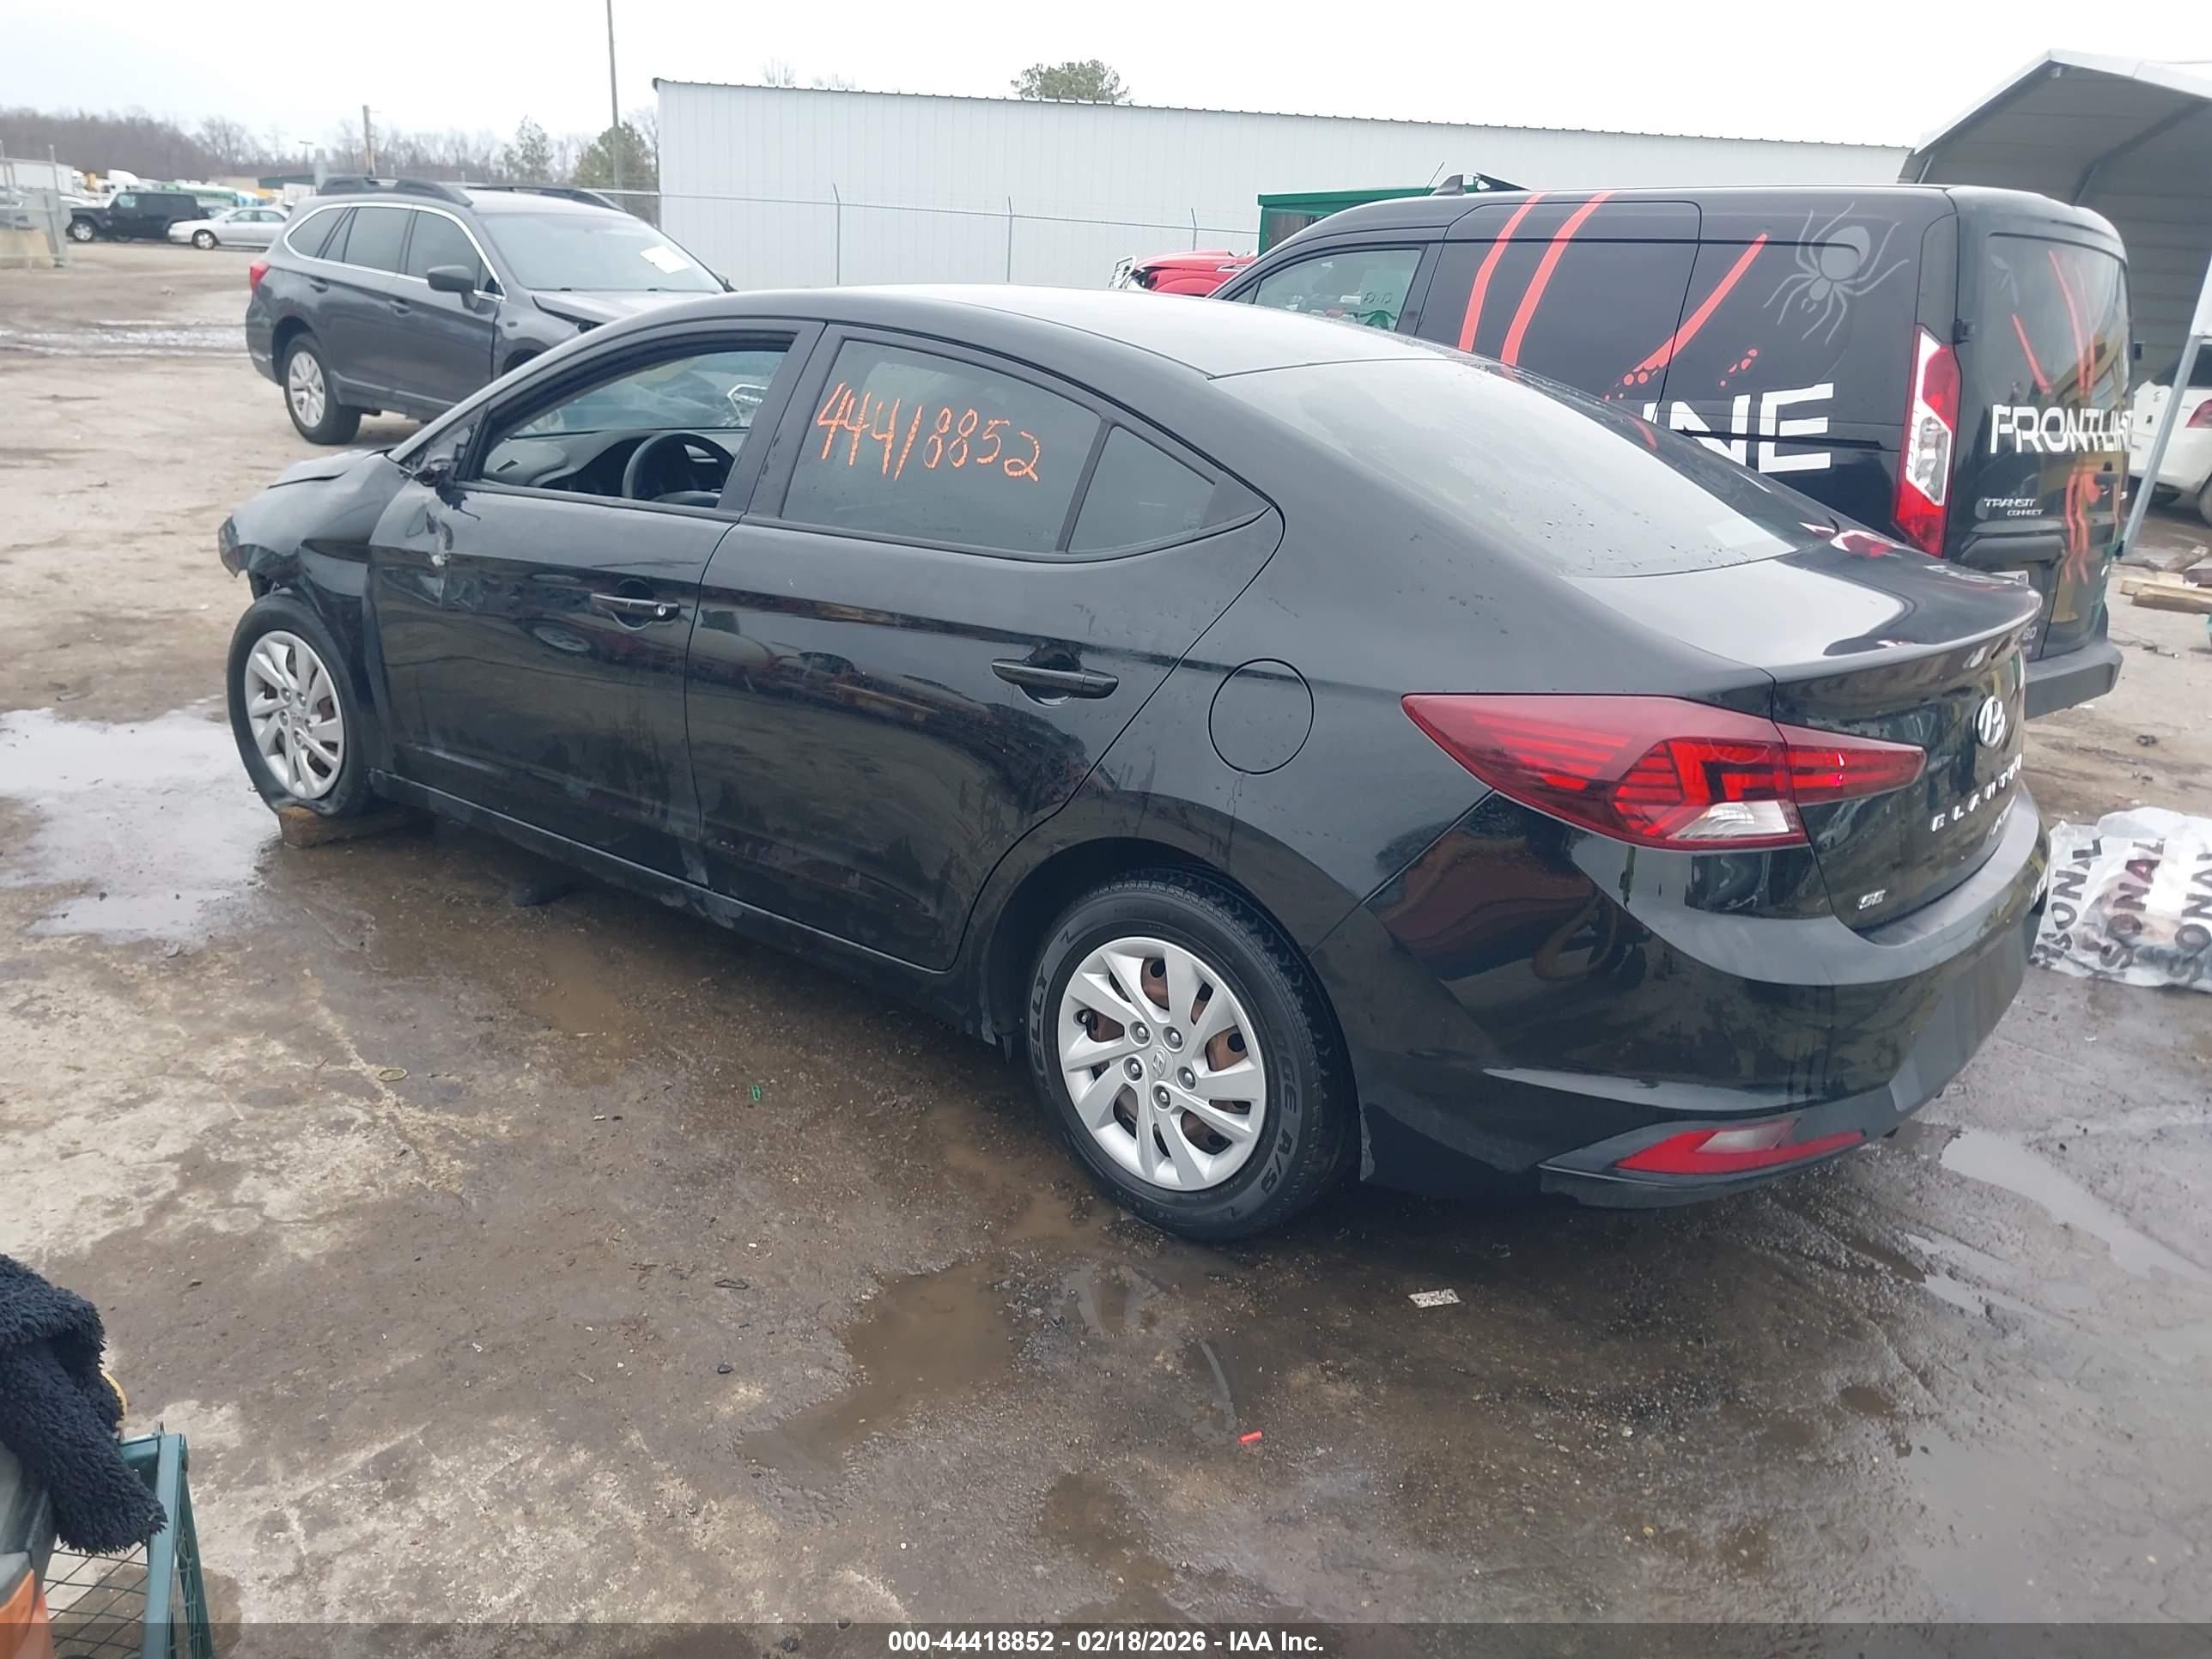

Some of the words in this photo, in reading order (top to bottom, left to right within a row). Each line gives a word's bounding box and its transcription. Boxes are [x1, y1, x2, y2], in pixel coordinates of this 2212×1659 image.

[1990, 404, 2132, 453] FRONTLIN
[1984, 497, 2036, 508] TRANSIT
[1858, 890, 1886, 910] SE
[1261, 1128, 1294, 1194] A/S
